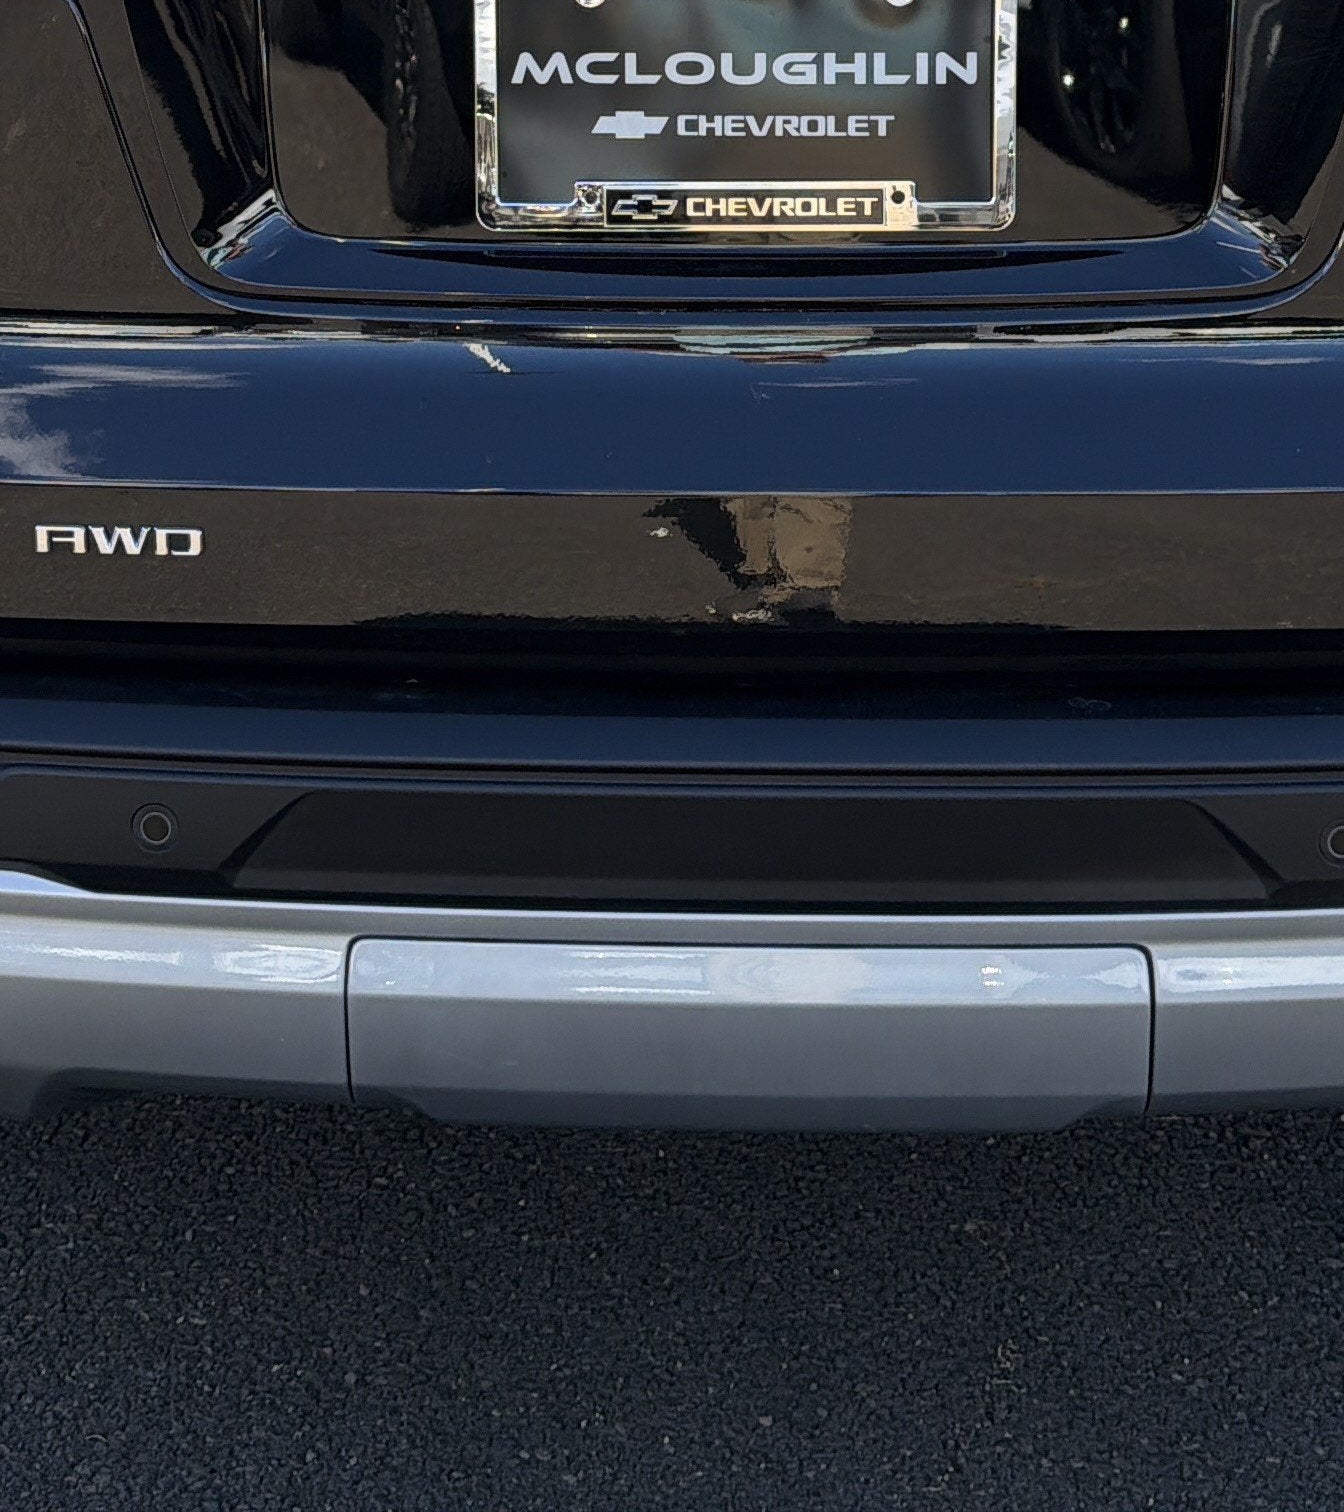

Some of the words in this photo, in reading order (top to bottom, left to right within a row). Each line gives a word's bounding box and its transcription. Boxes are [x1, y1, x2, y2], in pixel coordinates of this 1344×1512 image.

[510, 51, 979, 86] MCLOUGHLIN
[676, 114, 896, 137] CHEVROLET
[685, 196, 879, 218] CHEVROLET
[34, 525, 204, 557] AWD
